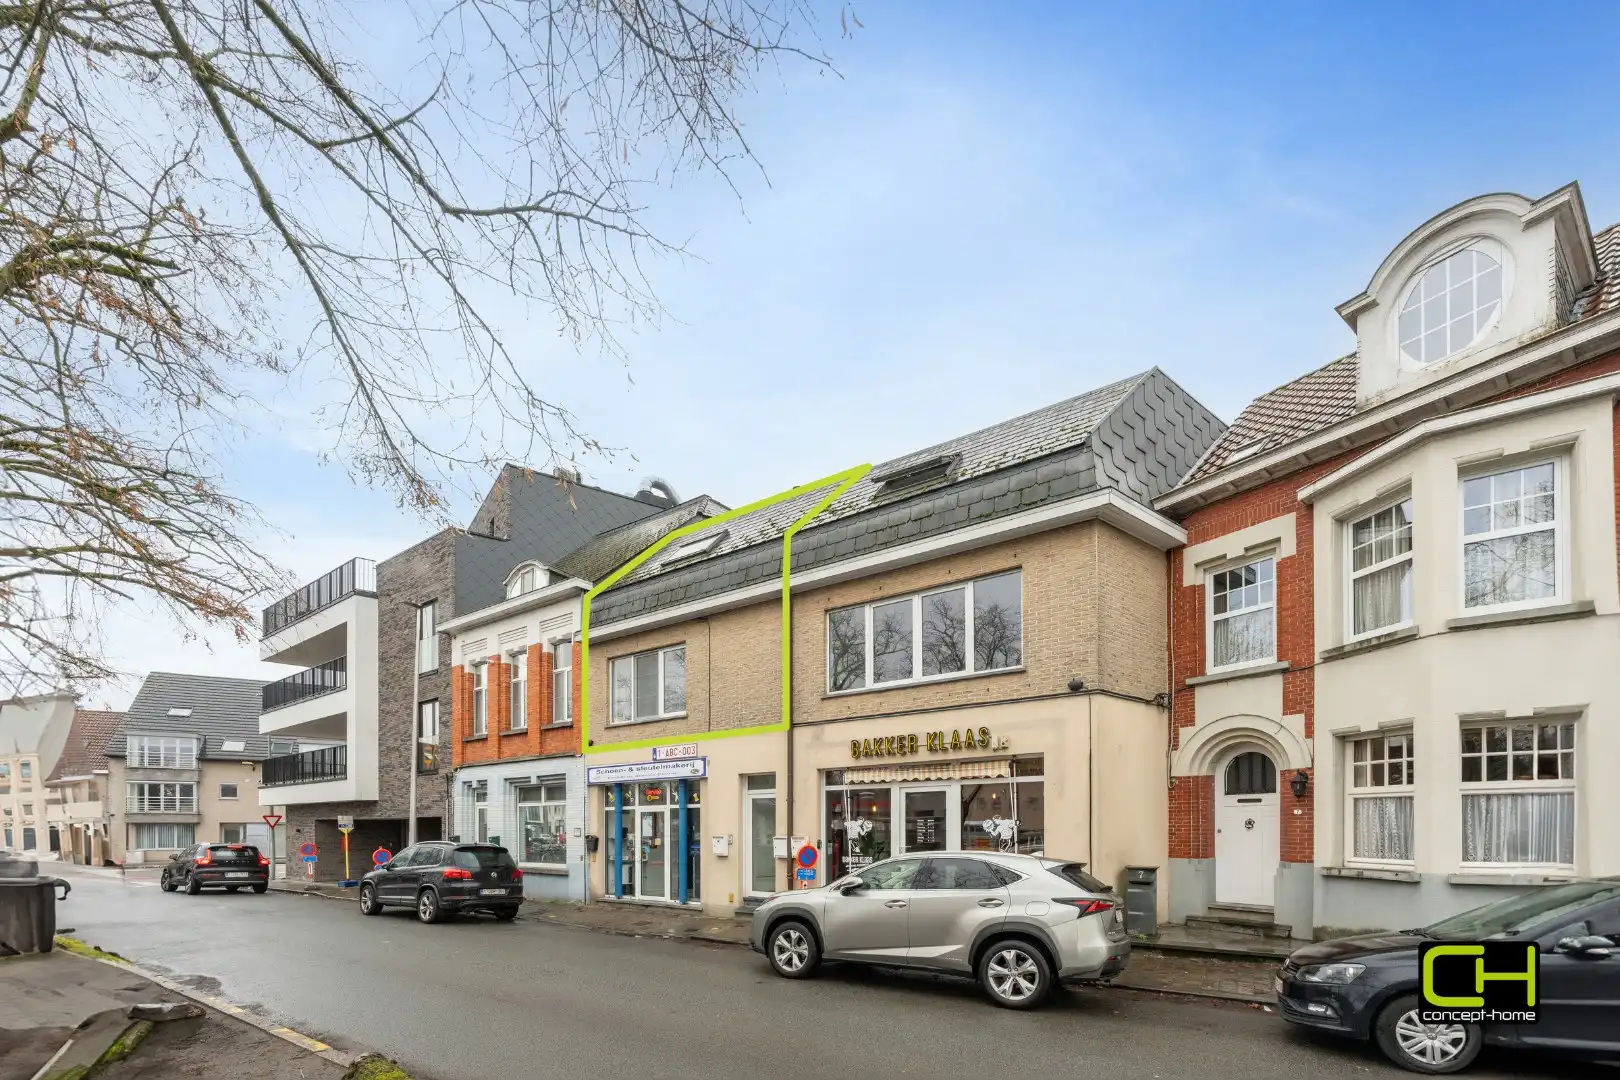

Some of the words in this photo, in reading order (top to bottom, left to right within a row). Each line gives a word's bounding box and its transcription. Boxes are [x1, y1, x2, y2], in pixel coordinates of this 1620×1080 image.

[851, 734, 918, 759] BAKKER
[926, 727, 989, 752] KLAAS
[596, 767, 626, 775] Schoen-
[636, 762, 695, 772] sleutelmakerij
[1138, 870, 1144, 879] 7
